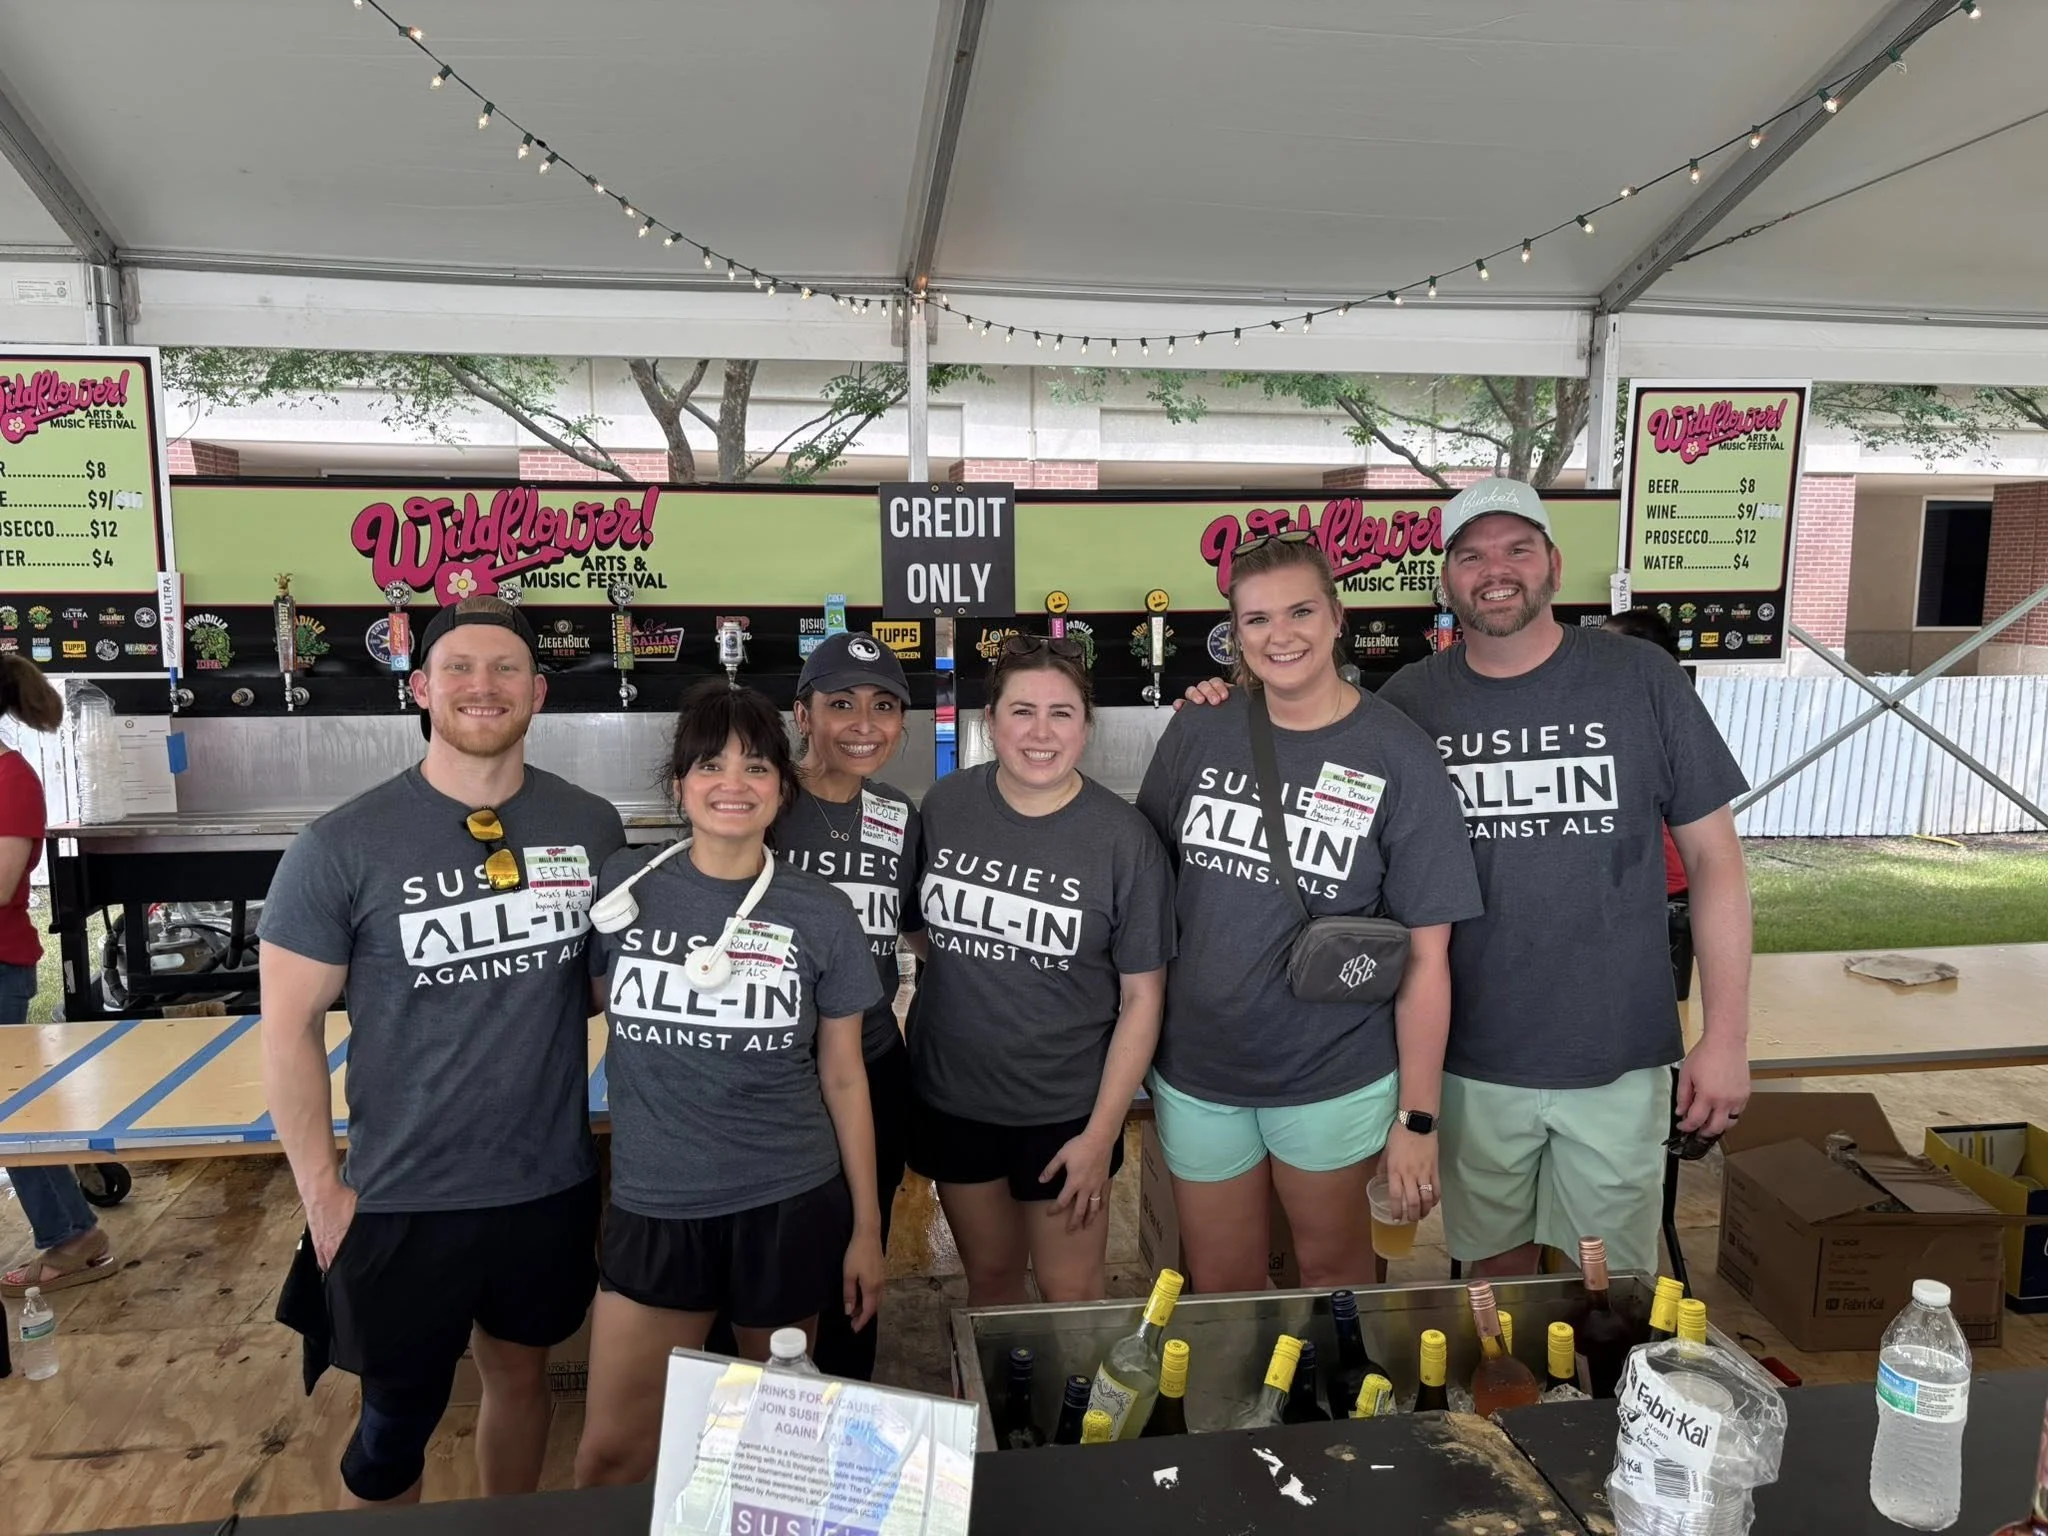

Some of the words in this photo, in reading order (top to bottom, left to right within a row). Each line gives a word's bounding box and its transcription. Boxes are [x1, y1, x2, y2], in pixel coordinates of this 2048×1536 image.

[85, 409, 112, 419] ARTS
[116, 409, 125, 419] &
[50, 419, 85, 429] MUSIC
[89, 419, 137, 430] FESTIVAL
[1647, 398, 1788, 454] Wildflower!
[1718, 442, 1745, 451] MUSIC
[1748, 442, 1784, 451] FESTIVAL
[1746, 434, 1767, 442] ARTS
[86, 460, 106, 480] $8
[890, 497, 1006, 538] CREDIT
[90, 519, 118, 539] $12
[351, 486, 661, 594] Wildflower!
[92, 548, 114, 568] $4
[580, 556, 626, 571] ARTS
[633, 556, 647, 571] &
[1396, 561, 1436, 575] ARTS
[520, 573, 581, 588] MUSIC
[587, 573, 668, 588] FESTIVAL
[907, 563, 992, 603] ONLY
[1343, 577, 1394, 592] MUSIC
[1400, 576, 1440, 591] FEST
[163, 577, 174, 614] ULTRA
[1619, 578, 1628, 610] ULTRA
[62, 611, 88, 619] ULTRA
[184, 613, 228, 631] HOPADILLO
[800, 618, 826, 633] BISHO
[1065, 620, 1094, 635] PADILLO
[631, 635, 679, 646] DALLAS
[875, 628, 917, 642] TUPPS
[64, 643, 85, 651] TUPPS
[633, 645, 676, 655] BLONDE
[1436, 722, 1607, 760] SUSIE'S
[1321, 780, 1341, 794] Erin
[1348, 787, 1375, 803] Brown
[865, 803, 900, 822] NICOLE
[1310, 808, 1340, 822] Against
[1342, 818, 1361, 830] ALS
[1465, 819, 1550, 839] GAINST
[1562, 816, 1615, 835] ALS
[536, 866, 581, 880] ERIN
[788, 850, 899, 881] USIE'S
[1185, 849, 1279, 885] AGAINS
[1297, 876, 1339, 899] ALS
[933, 848, 1081, 902] SUSIE'S
[565, 901, 582, 910] ALS
[923, 883, 1077, 950] ALL-IN
[729, 935, 769, 952] Rachel
[927, 927, 1019, 962] AGAINST
[1029, 955, 1070, 972] ALS
[413, 951, 548, 988] AGAINST
[746, 968, 768, 980] ALS
[614, 966, 798, 1019] ALL-IN
[616, 1021, 732, 1050] AGAINST
[743, 1031, 794, 1051] ALS
[799, 1391, 822, 1405] FOR
[759, 1403, 786, 1417] JOIN
[1637, 1382, 1710, 1449] Fabri-Kal
[775, 1422, 823, 1440] AGAINS
[762, 1444, 775, 1454] ALS
[778, 1458, 791, 1468] ALS
